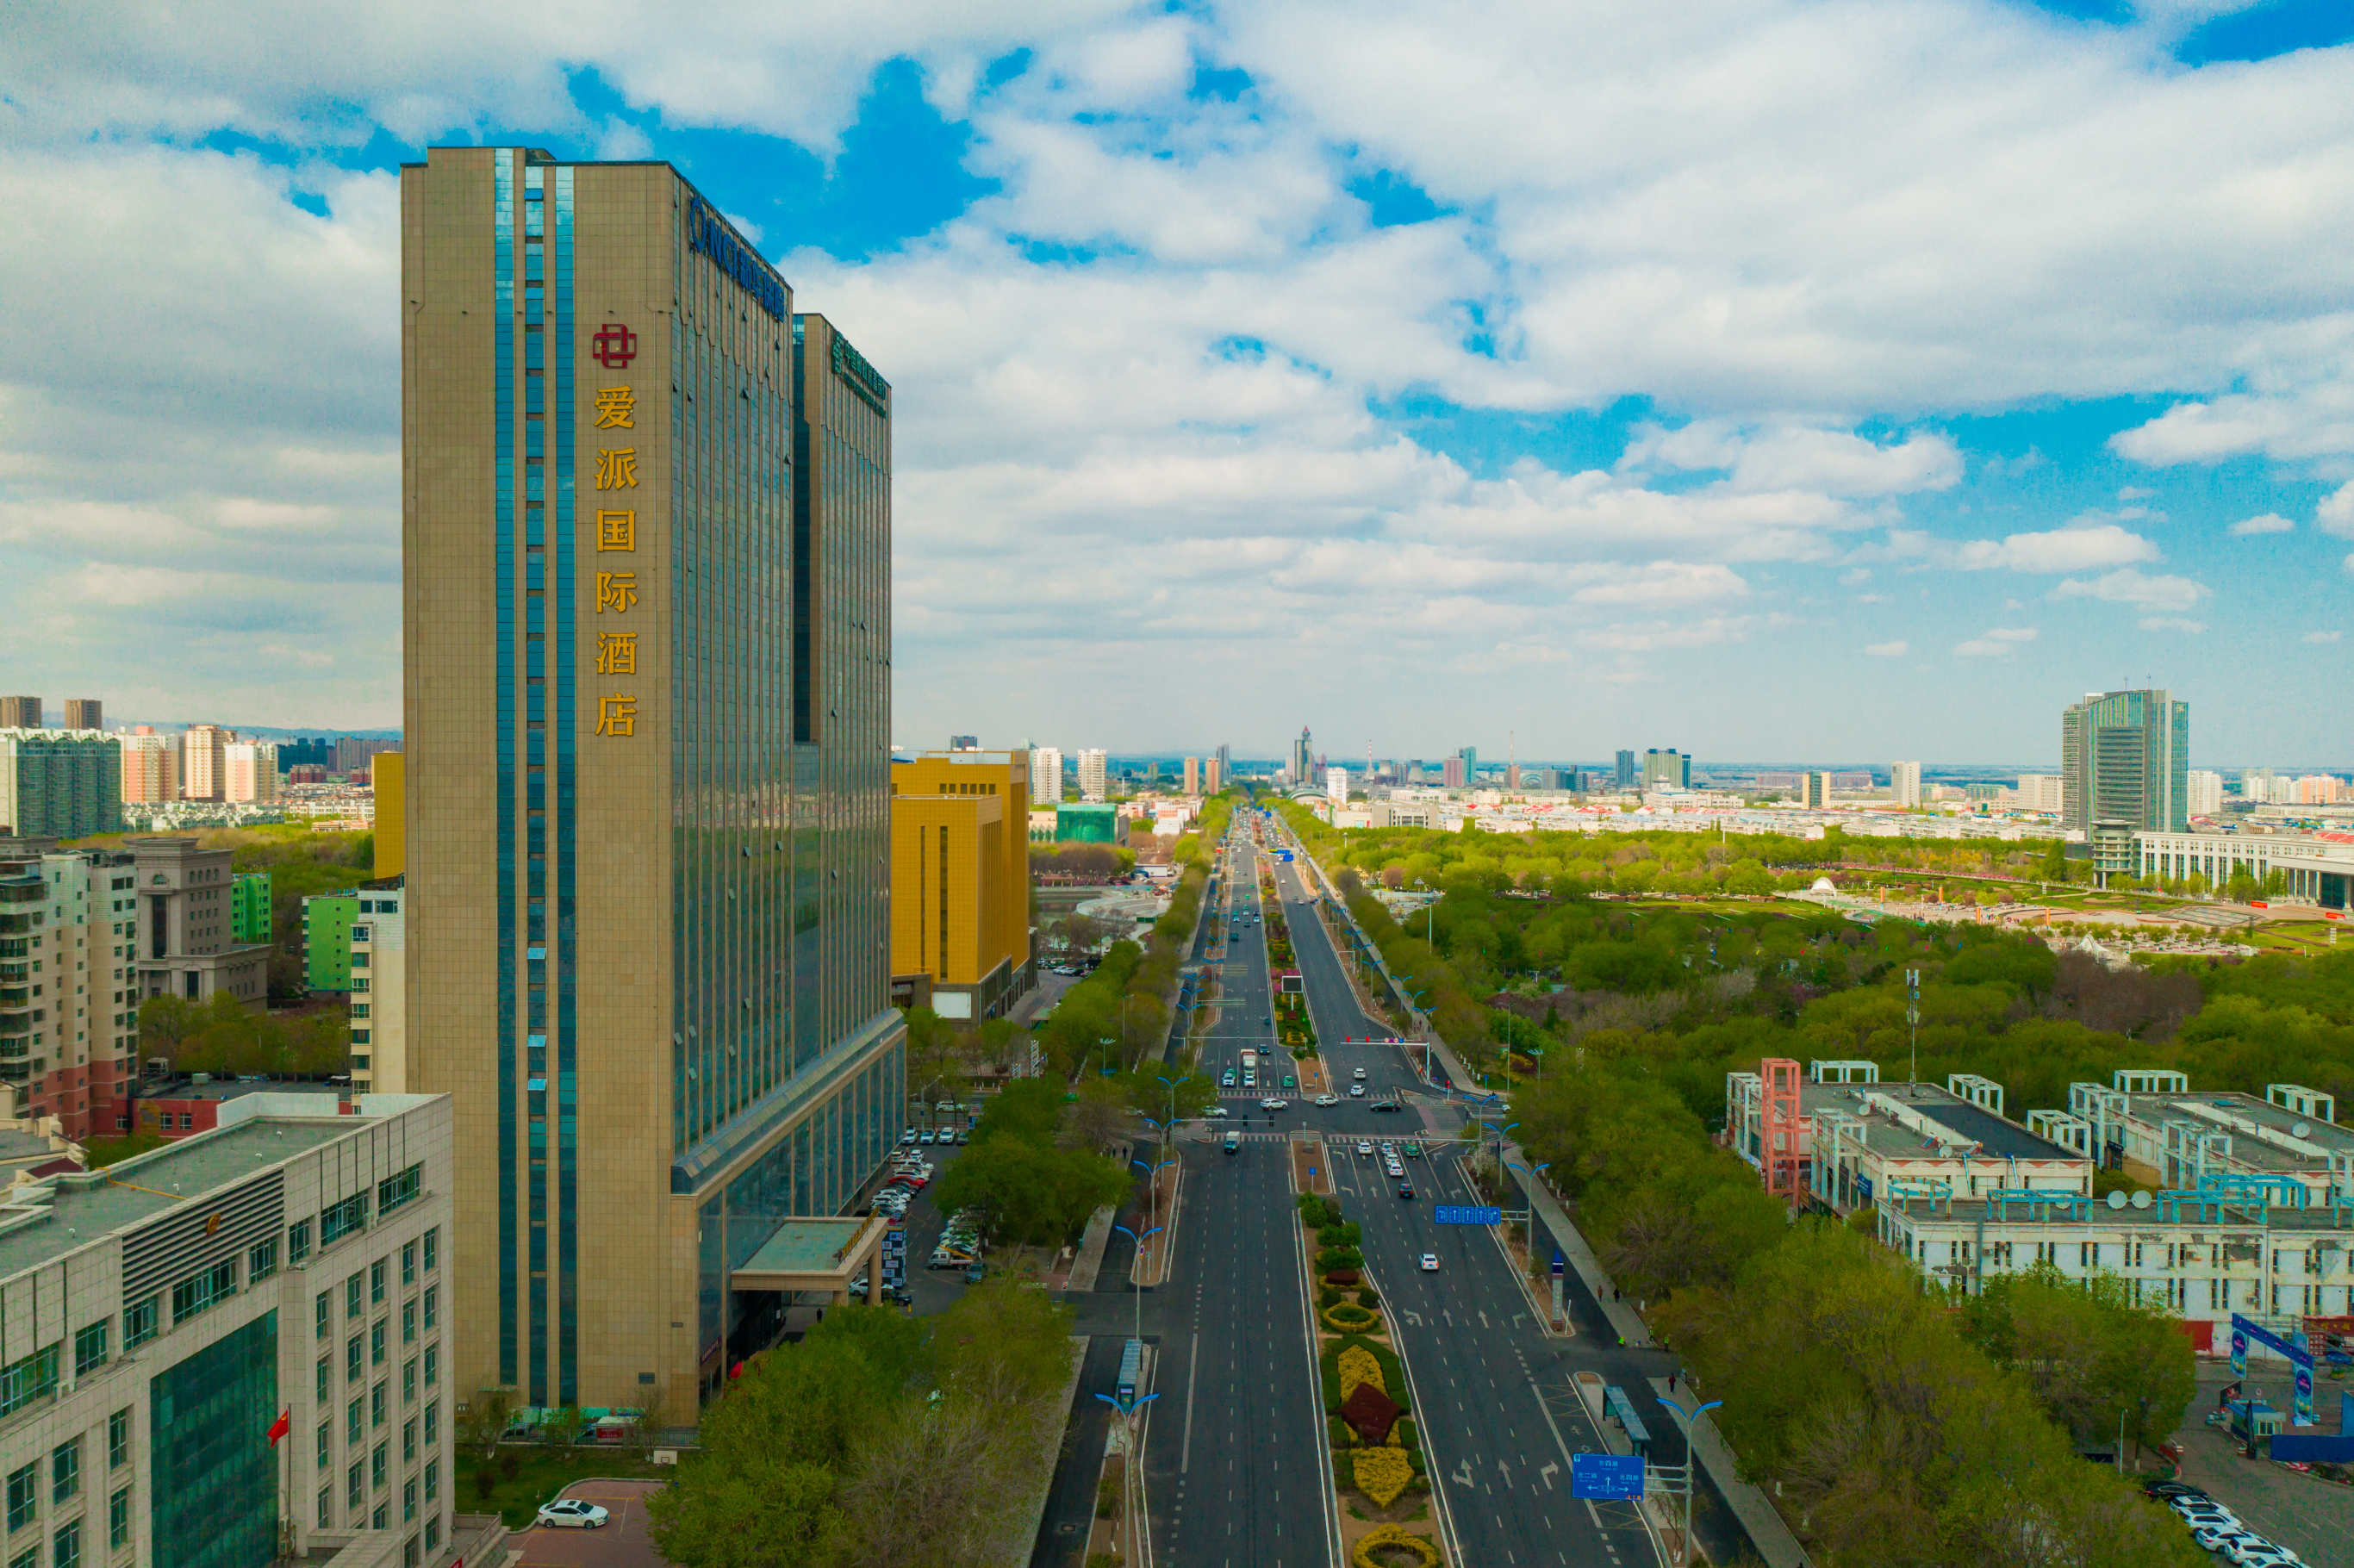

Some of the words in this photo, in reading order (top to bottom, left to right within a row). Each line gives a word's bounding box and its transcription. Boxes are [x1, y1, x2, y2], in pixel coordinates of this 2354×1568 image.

[709, 217, 738, 279] NCI
[739, 247, 785, 323] 新华保险
[594, 385, 638, 737] 爱派国际酒店
